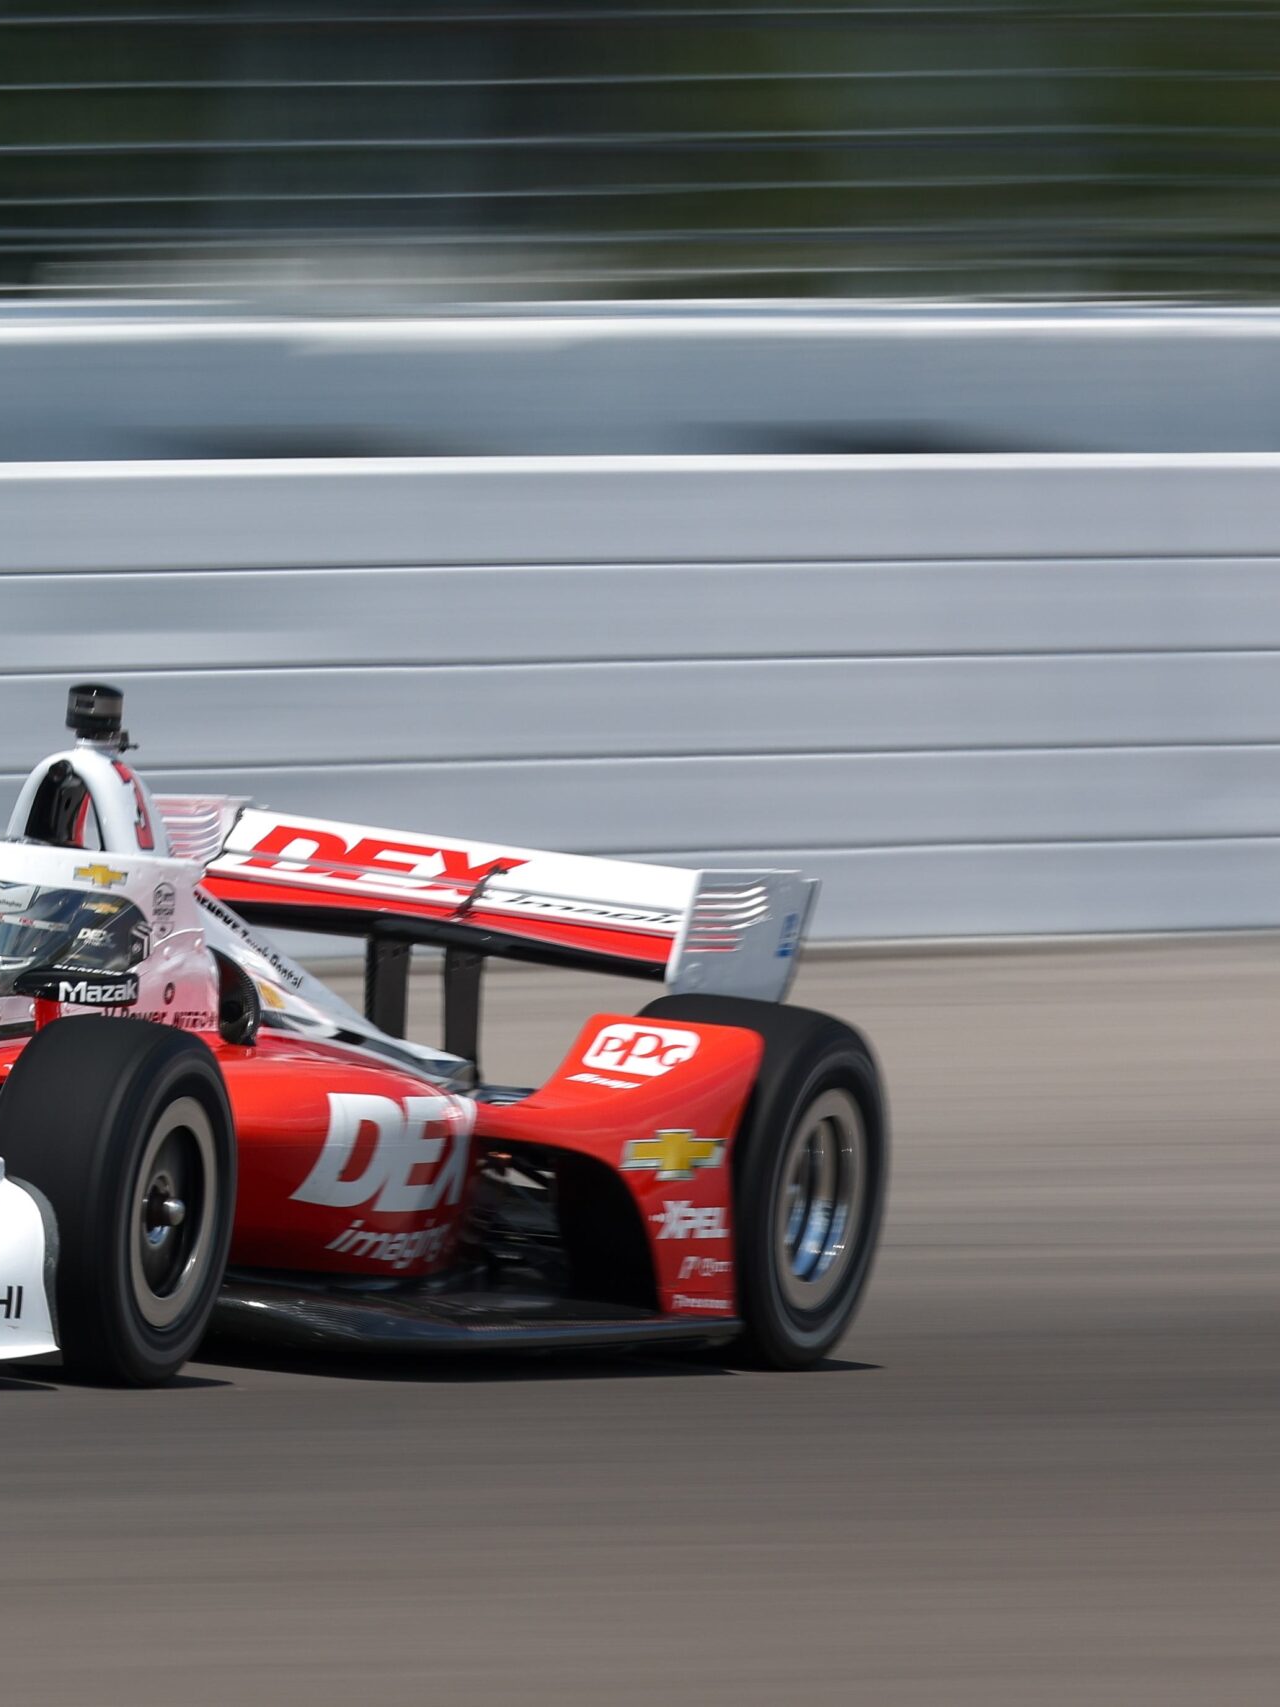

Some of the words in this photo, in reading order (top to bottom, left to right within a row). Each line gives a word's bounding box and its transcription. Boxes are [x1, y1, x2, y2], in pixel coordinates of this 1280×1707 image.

[238, 825, 531, 896] DEX
[58, 979, 138, 1003] Mazak
[593, 1031, 689, 1067] PPG
[656, 1200, 730, 1239] XPEL
